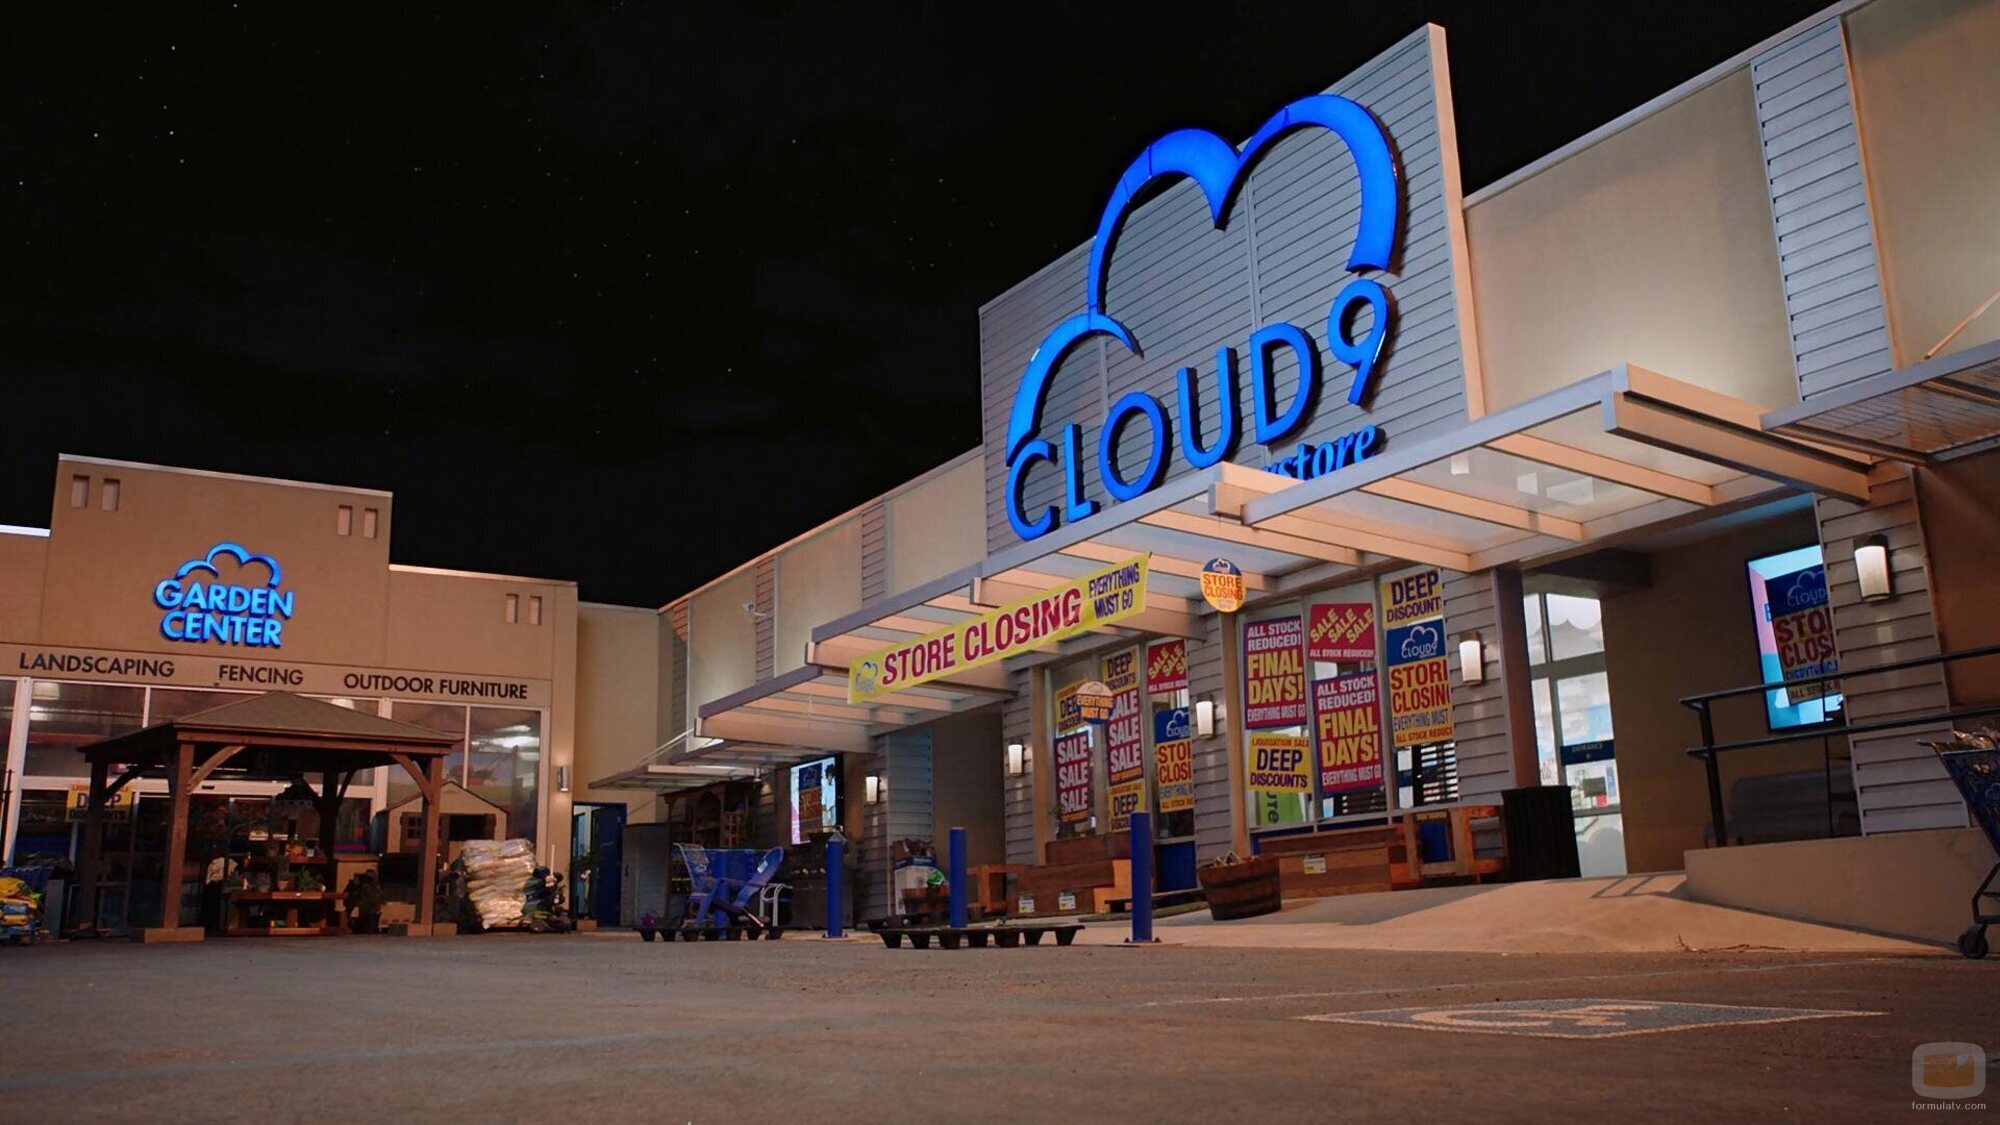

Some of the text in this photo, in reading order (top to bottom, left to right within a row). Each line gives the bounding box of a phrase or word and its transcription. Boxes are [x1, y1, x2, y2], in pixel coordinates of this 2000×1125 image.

[1088, 562, 1140, 599] EVERYTHING
[1202, 574, 1243, 589] STORE
[1204, 585, 1244, 601] CLOSING
[1391, 571, 1439, 606] DEEP
[154, 578, 294, 619] GARDEN
[1094, 589, 1134, 619] MUST GO
[1386, 596, 1441, 623] DISCOUNT
[160, 610, 282, 647] CENTER
[882, 587, 1082, 686] STORE CLOSING
[1247, 620, 1301, 639] ALL STOCK
[1310, 608, 1339, 643] SALE
[1328, 608, 1357, 643] SALE
[1346, 608, 1375, 643] SALE
[1247, 633, 1301, 652] REDUCED!
[1310, 649, 1321, 657] ALL
[1322, 649, 1341, 657] STOCK
[19, 652, 175, 678] LANDSCAPING
[218, 664, 304, 685] FENCING
[1107, 652, 1132, 678] DEEP
[1148, 647, 1170, 680] SALE
[1161, 644, 1184, 677] SALE
[1247, 649, 1303, 679] FINAL
[343, 673, 528, 700] OUTDOOR FURNITURE
[1249, 675, 1304, 705] DAYS!
[1317, 675, 1375, 697] ALL STOCK
[1318, 689, 1376, 711] REDUCED!
[1392, 686, 1450, 714] CLOSIN
[1247, 704, 1306, 722] EVERYTHING MUST GO
[1319, 706, 1378, 739] FINAL
[1394, 711, 1430, 732] EVERYTHING
[1109, 715, 1139, 747] SALE
[1395, 732, 1407, 744] ALL
[1057, 736, 1088, 765] SALE
[1110, 743, 1141, 773] SALE
[1257, 748, 1303, 771] DEEP
[1321, 733, 1379, 767] DAYS!
[1059, 761, 1088, 789] SALE
[1250, 773, 1308, 788] DISCOUNTS
[1321, 768, 1358, 786] EVERYTHING
[1358, 765, 1373, 782] MUST
[1060, 787, 1088, 815] SALE
[1113, 793, 1139, 817] DEEP
